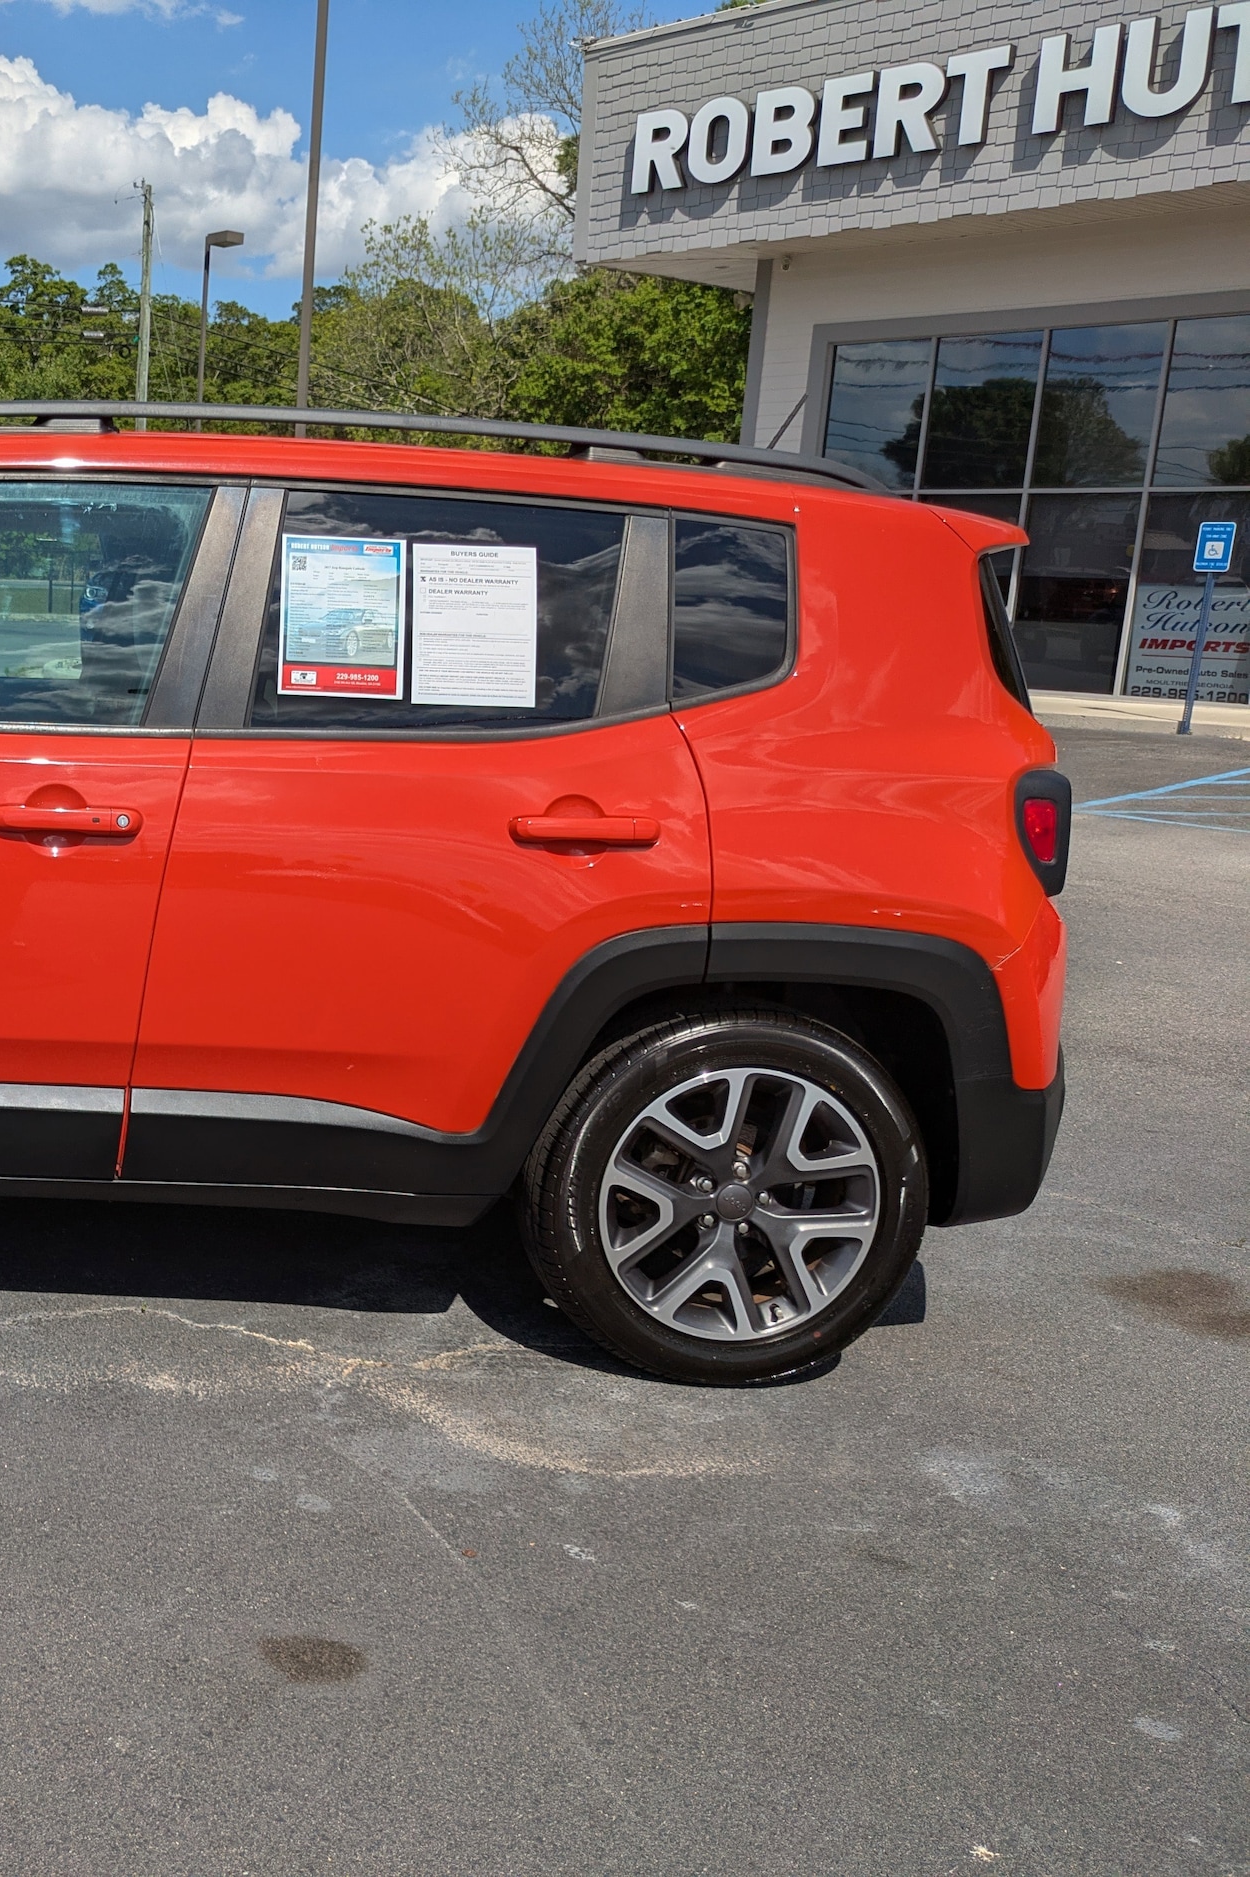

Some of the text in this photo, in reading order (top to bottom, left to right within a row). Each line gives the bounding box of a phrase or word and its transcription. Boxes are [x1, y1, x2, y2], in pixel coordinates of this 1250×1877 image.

[630, 43, 1016, 195] ROBERT
[1143, 589, 1250, 612] Robert
[1141, 611, 1250, 634] Hutson
[1139, 638, 1250, 654] IMPORTS
[1135, 665, 1249, 679] Pre-Owned uto Sales
[723, 1193, 747, 1212] Jeep
